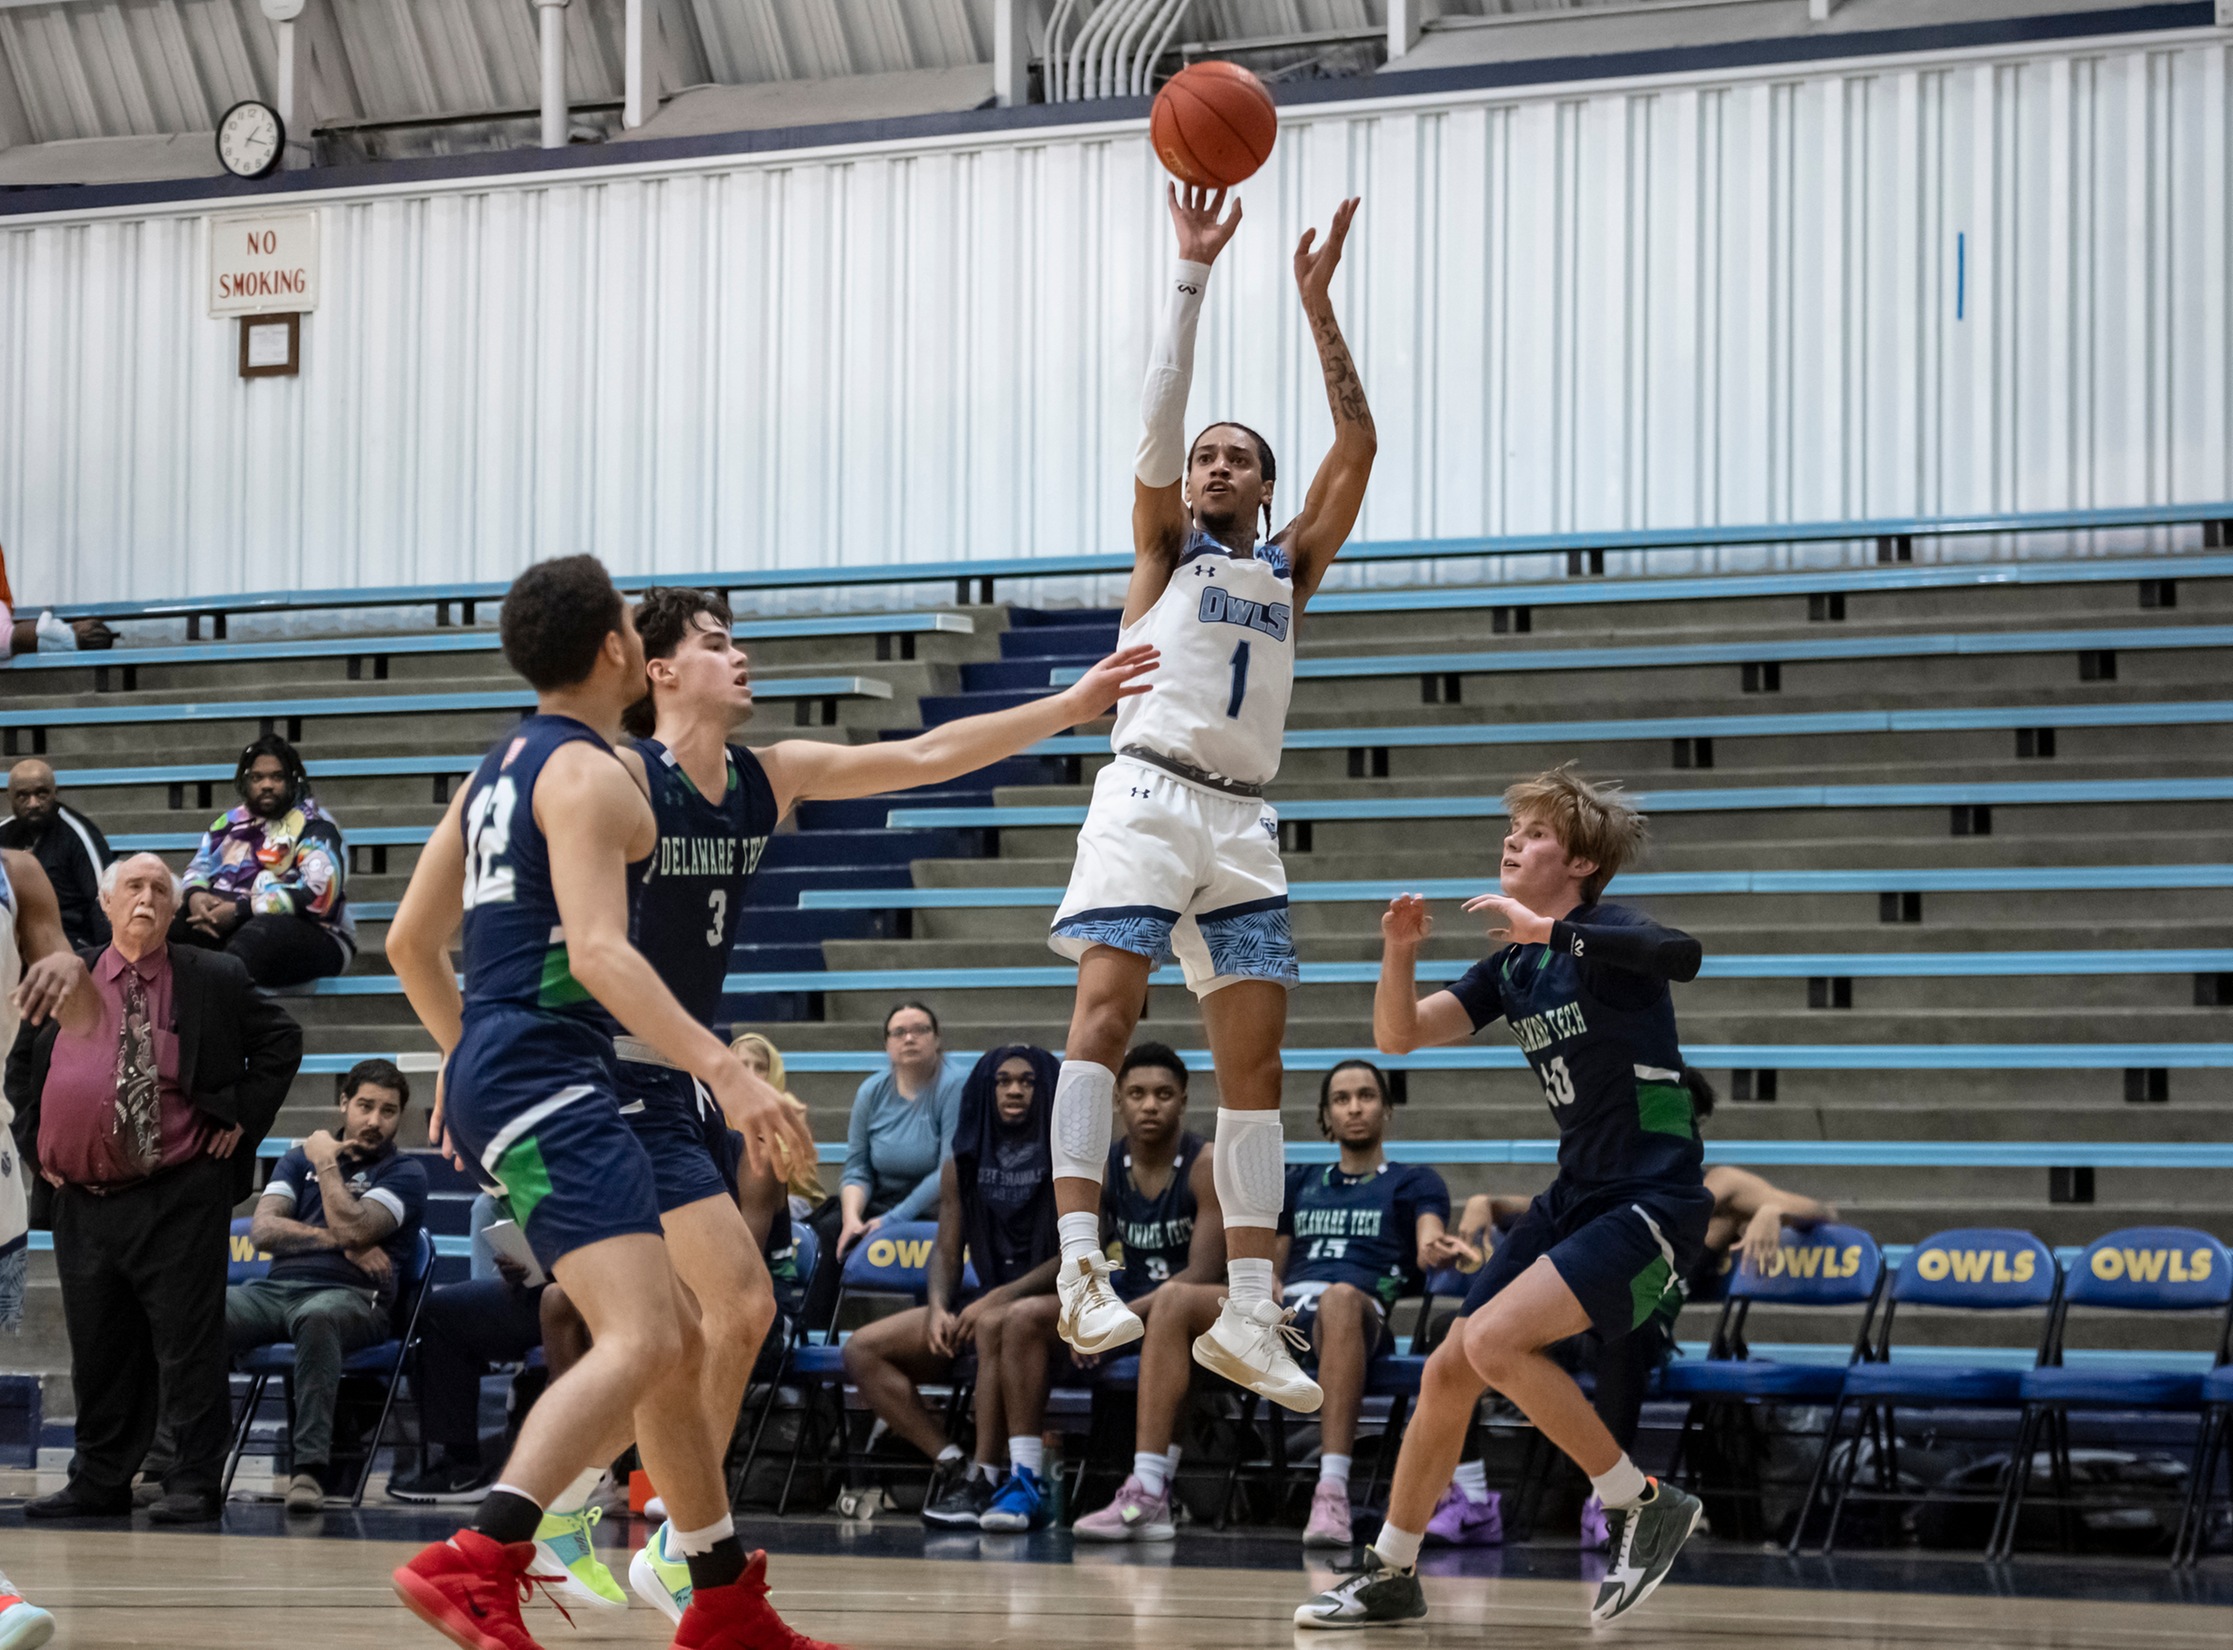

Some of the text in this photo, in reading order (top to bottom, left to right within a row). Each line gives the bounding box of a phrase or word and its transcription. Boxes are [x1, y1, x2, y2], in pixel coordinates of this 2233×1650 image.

[247, 231, 276, 255] NO
[218, 269, 305, 298] SMOKING
[1198, 586, 1290, 642] OWLS
[1225, 639, 1251, 720] 1
[462, 776, 517, 910] 12
[660, 836, 736, 876] DELAWARE
[706, 889, 727, 947] 3
[1545, 1001, 1588, 1041] TECH
[1350, 1209, 1382, 1237] TECH
[867, 1239, 934, 1269] OW
[1917, 1248, 2036, 1283] OWLS
[2091, 1246, 2213, 1283] OWLS
